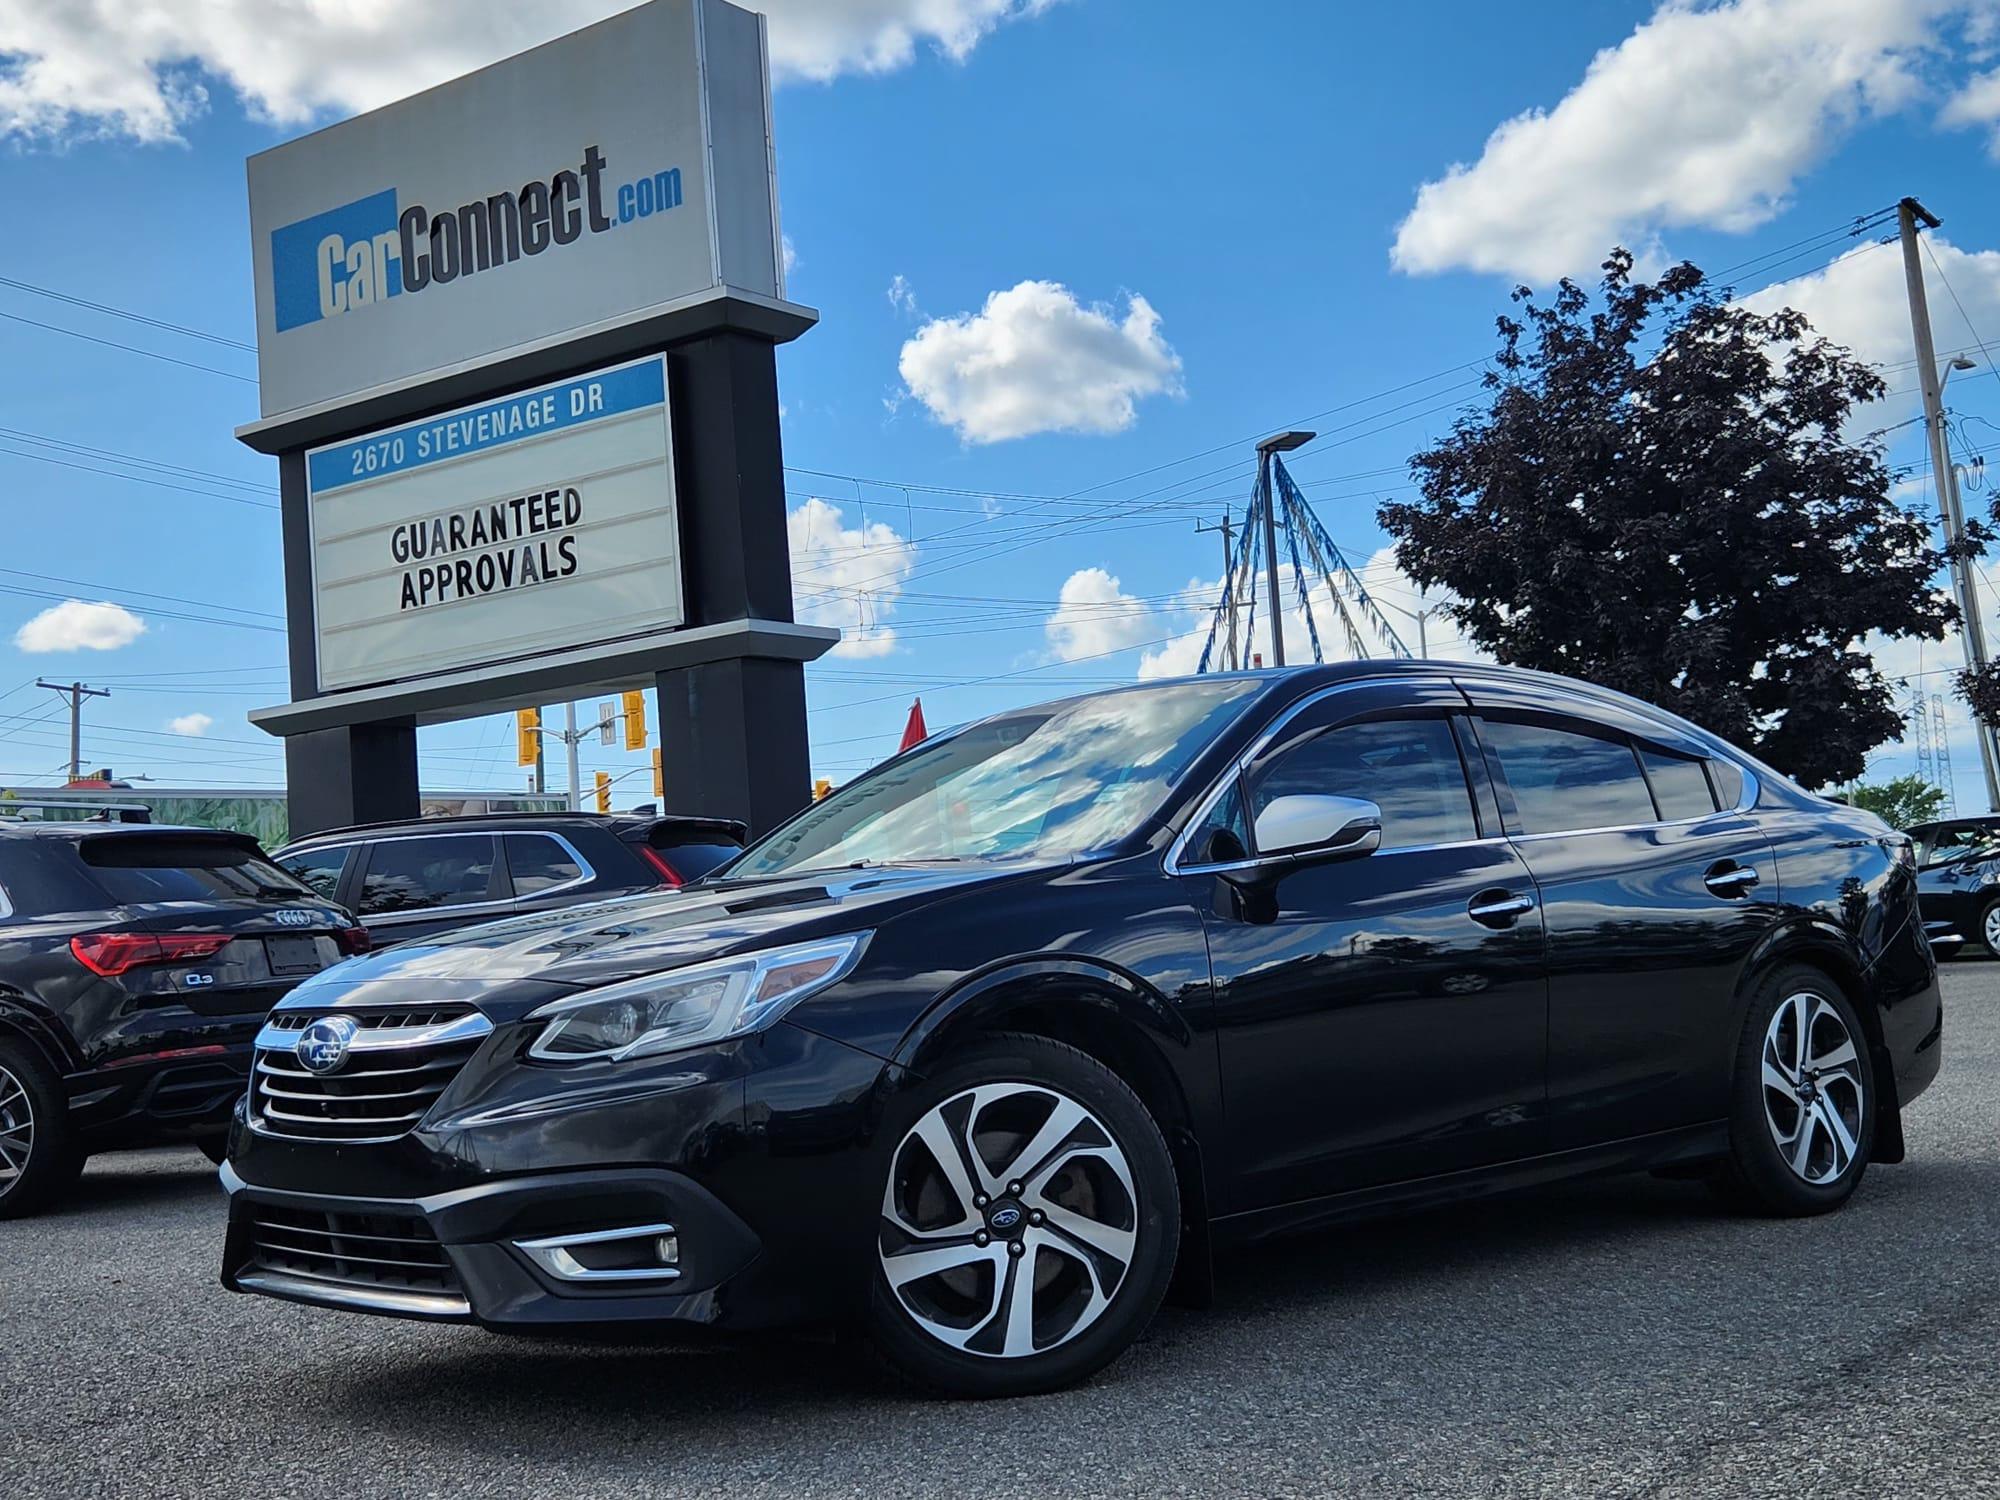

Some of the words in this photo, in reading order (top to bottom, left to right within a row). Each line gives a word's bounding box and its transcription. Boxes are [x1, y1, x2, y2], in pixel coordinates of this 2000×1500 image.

[351, 438, 405, 475] 2670
[417, 395, 556, 458] STEVENAGE
[570, 383, 604, 417] DR
[391, 487, 583, 564] GUARANTEED
[400, 535, 578, 610] APPROVALS
[186, 974, 213, 985] Q3
